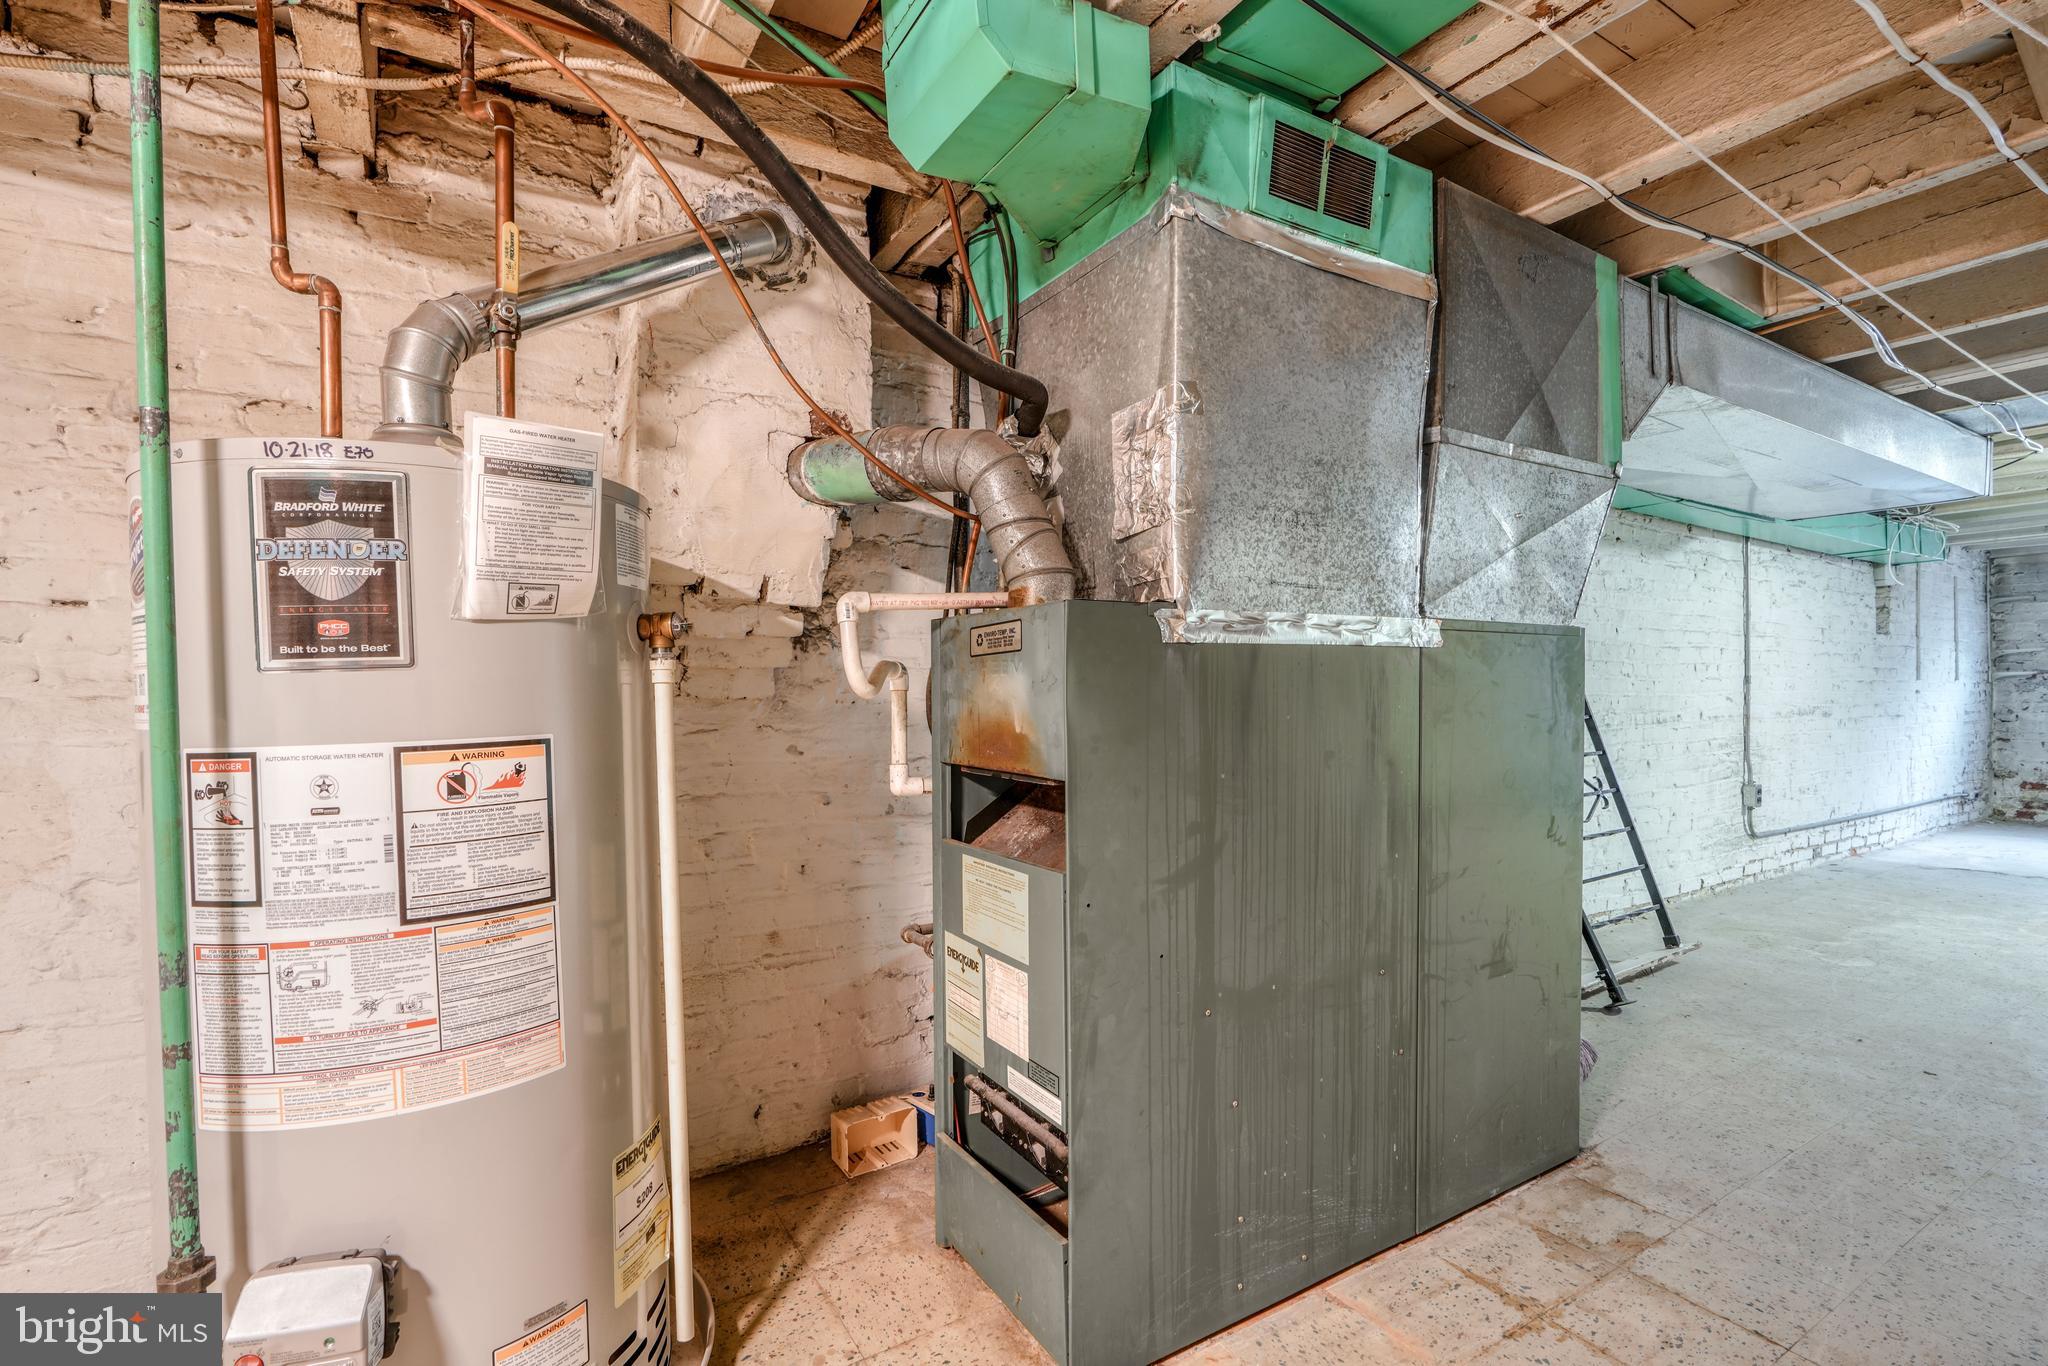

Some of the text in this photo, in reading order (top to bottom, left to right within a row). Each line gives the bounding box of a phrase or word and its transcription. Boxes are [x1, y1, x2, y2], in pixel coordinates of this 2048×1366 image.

[509, 428, 538, 438] GAS-FIRED
[273, 501, 383, 513] BRADFORD WHITE
[256, 538, 408, 561] DEFENDER
[278, 566, 382, 577] SAFETY SYSTEM
[280, 646, 304, 654] Built
[321, 645, 336, 654] be
[338, 644, 358, 653] the
[360, 644, 388, 652] Best
[462, 750, 505, 760] WARNING
[208, 762, 242, 771] DANGER
[490, 916, 515, 924] WARNING
[492, 934, 516, 943] WARNING
[529, 1319, 566, 1344] WARNING
